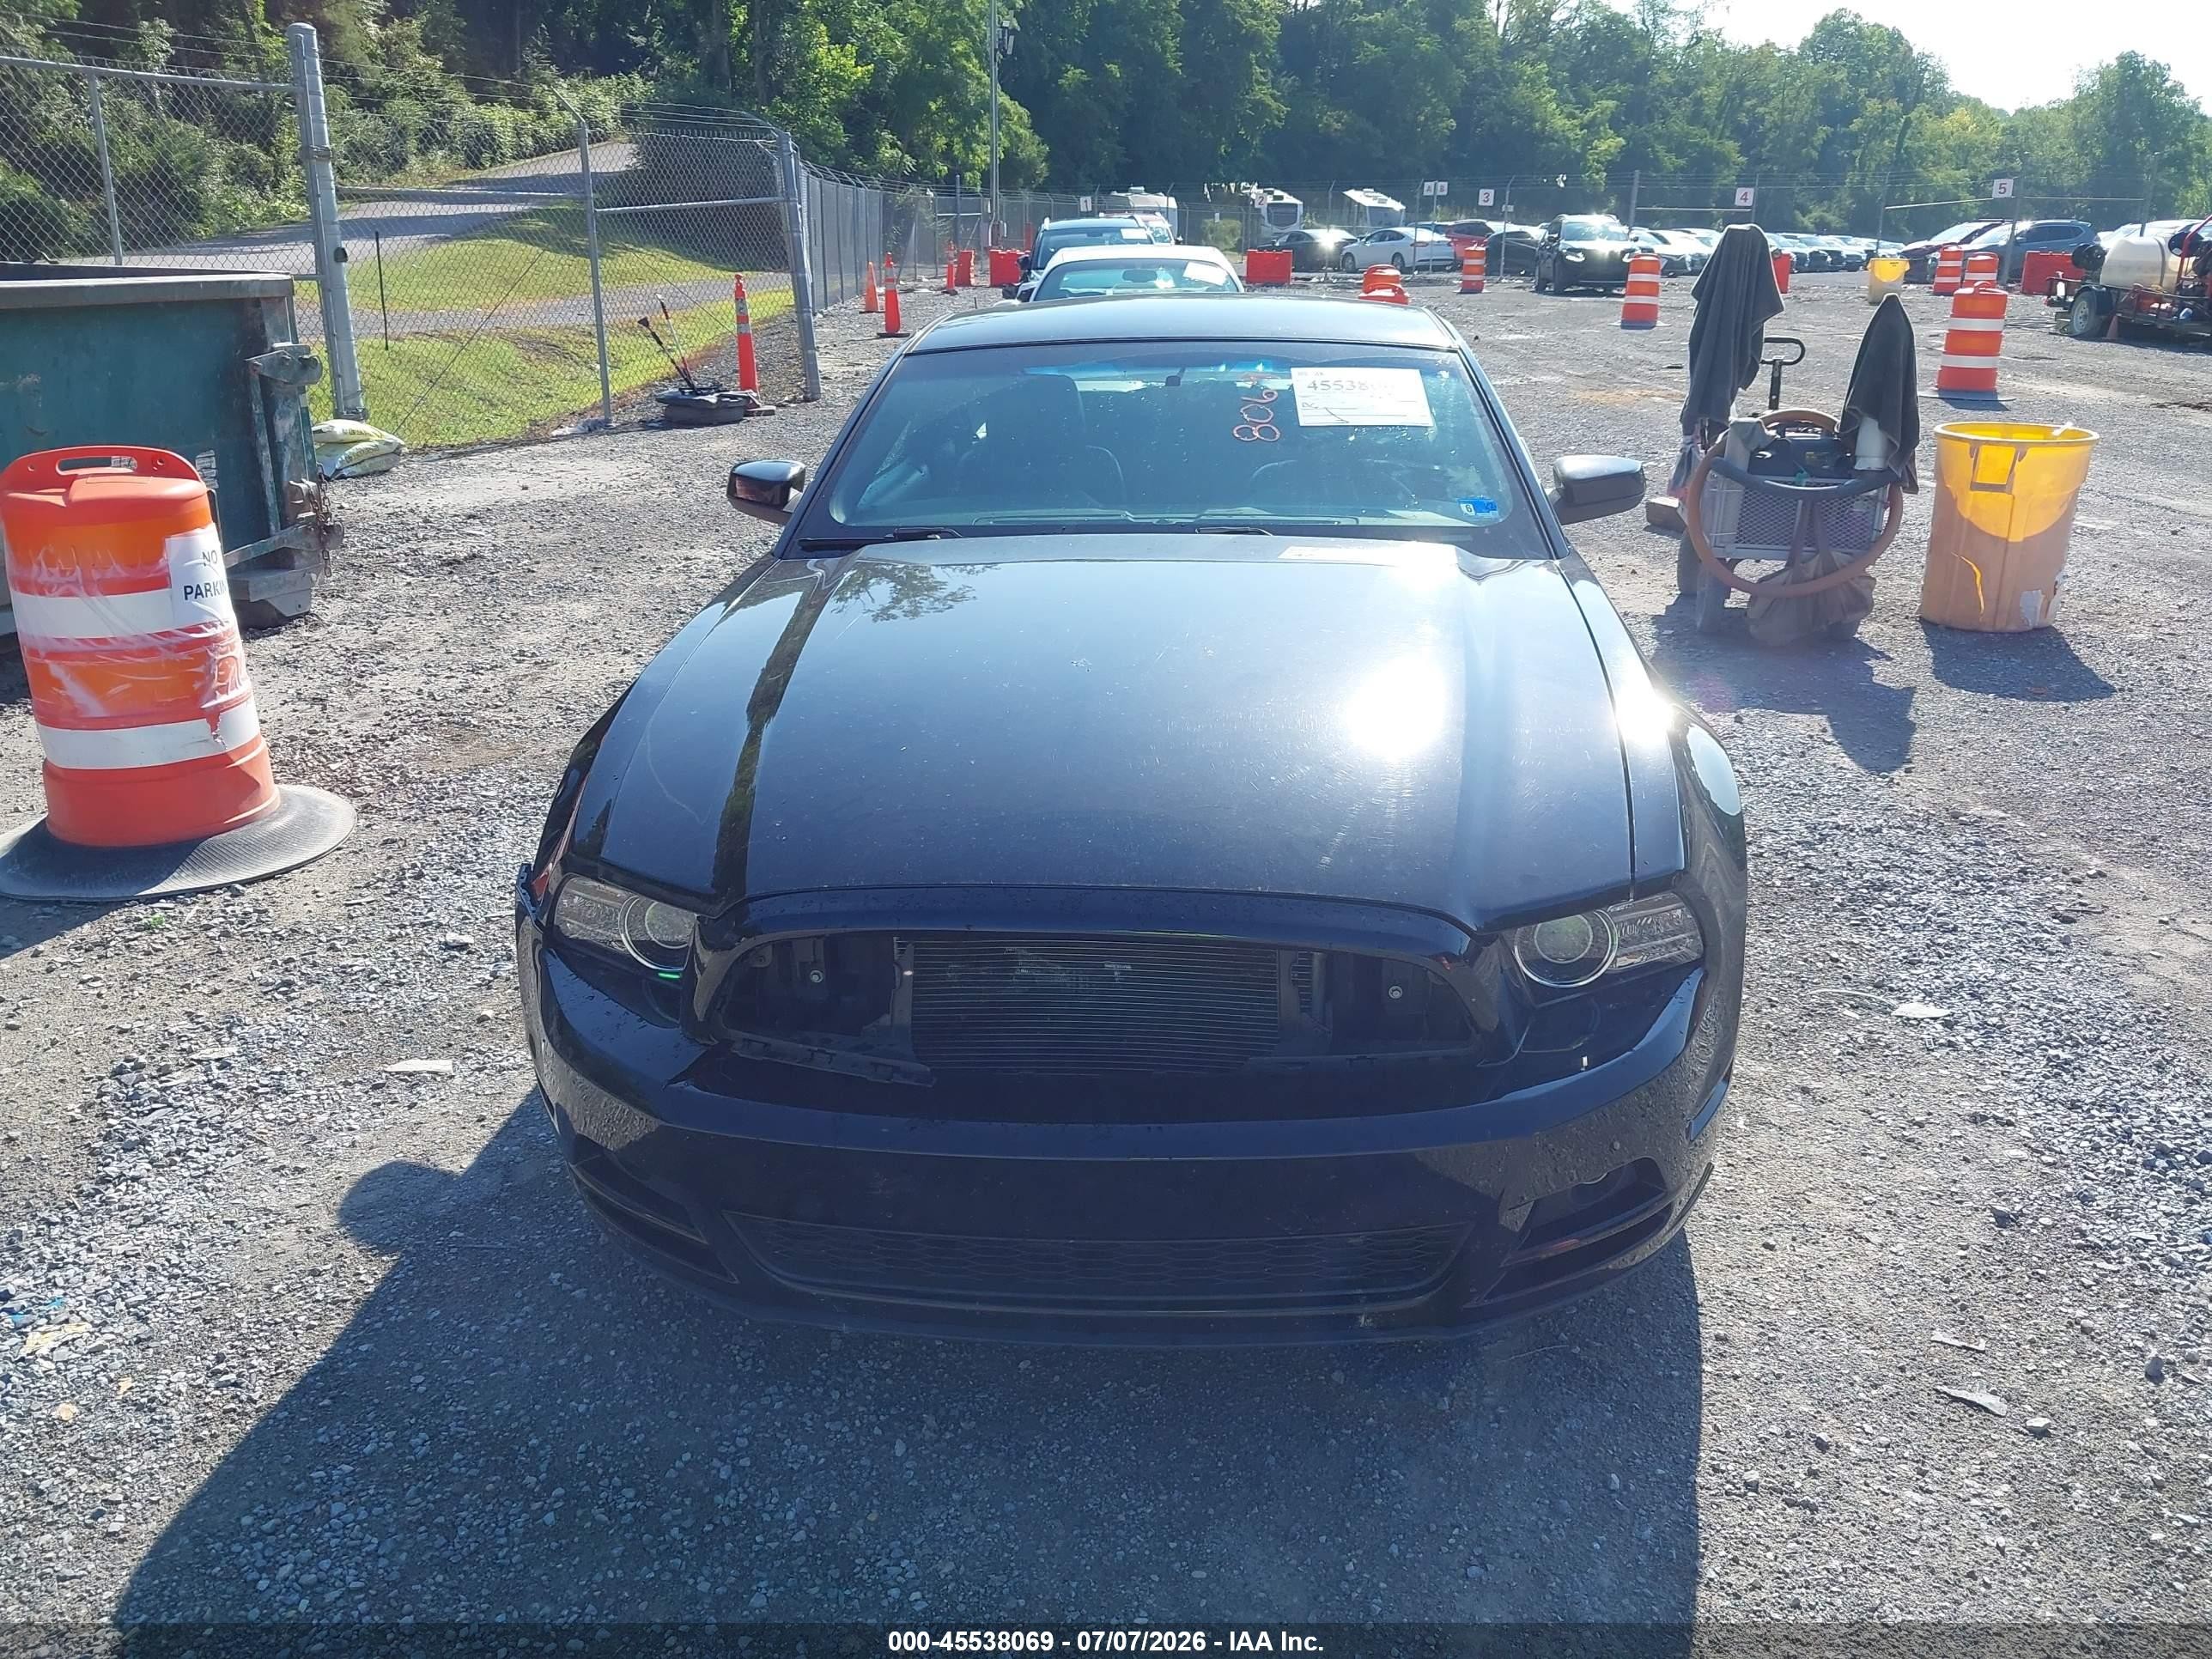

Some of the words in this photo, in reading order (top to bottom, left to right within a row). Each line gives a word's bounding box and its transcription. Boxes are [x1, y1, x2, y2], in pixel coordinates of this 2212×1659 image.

[1998, 182, 2007, 195] 5
[1258, 197, 1265, 206] 2
[1482, 191, 1491, 203] 3
[1740, 191, 1749, 203] 4
[1465, 504, 1473, 513] 6
[202, 550, 218, 567] NO
